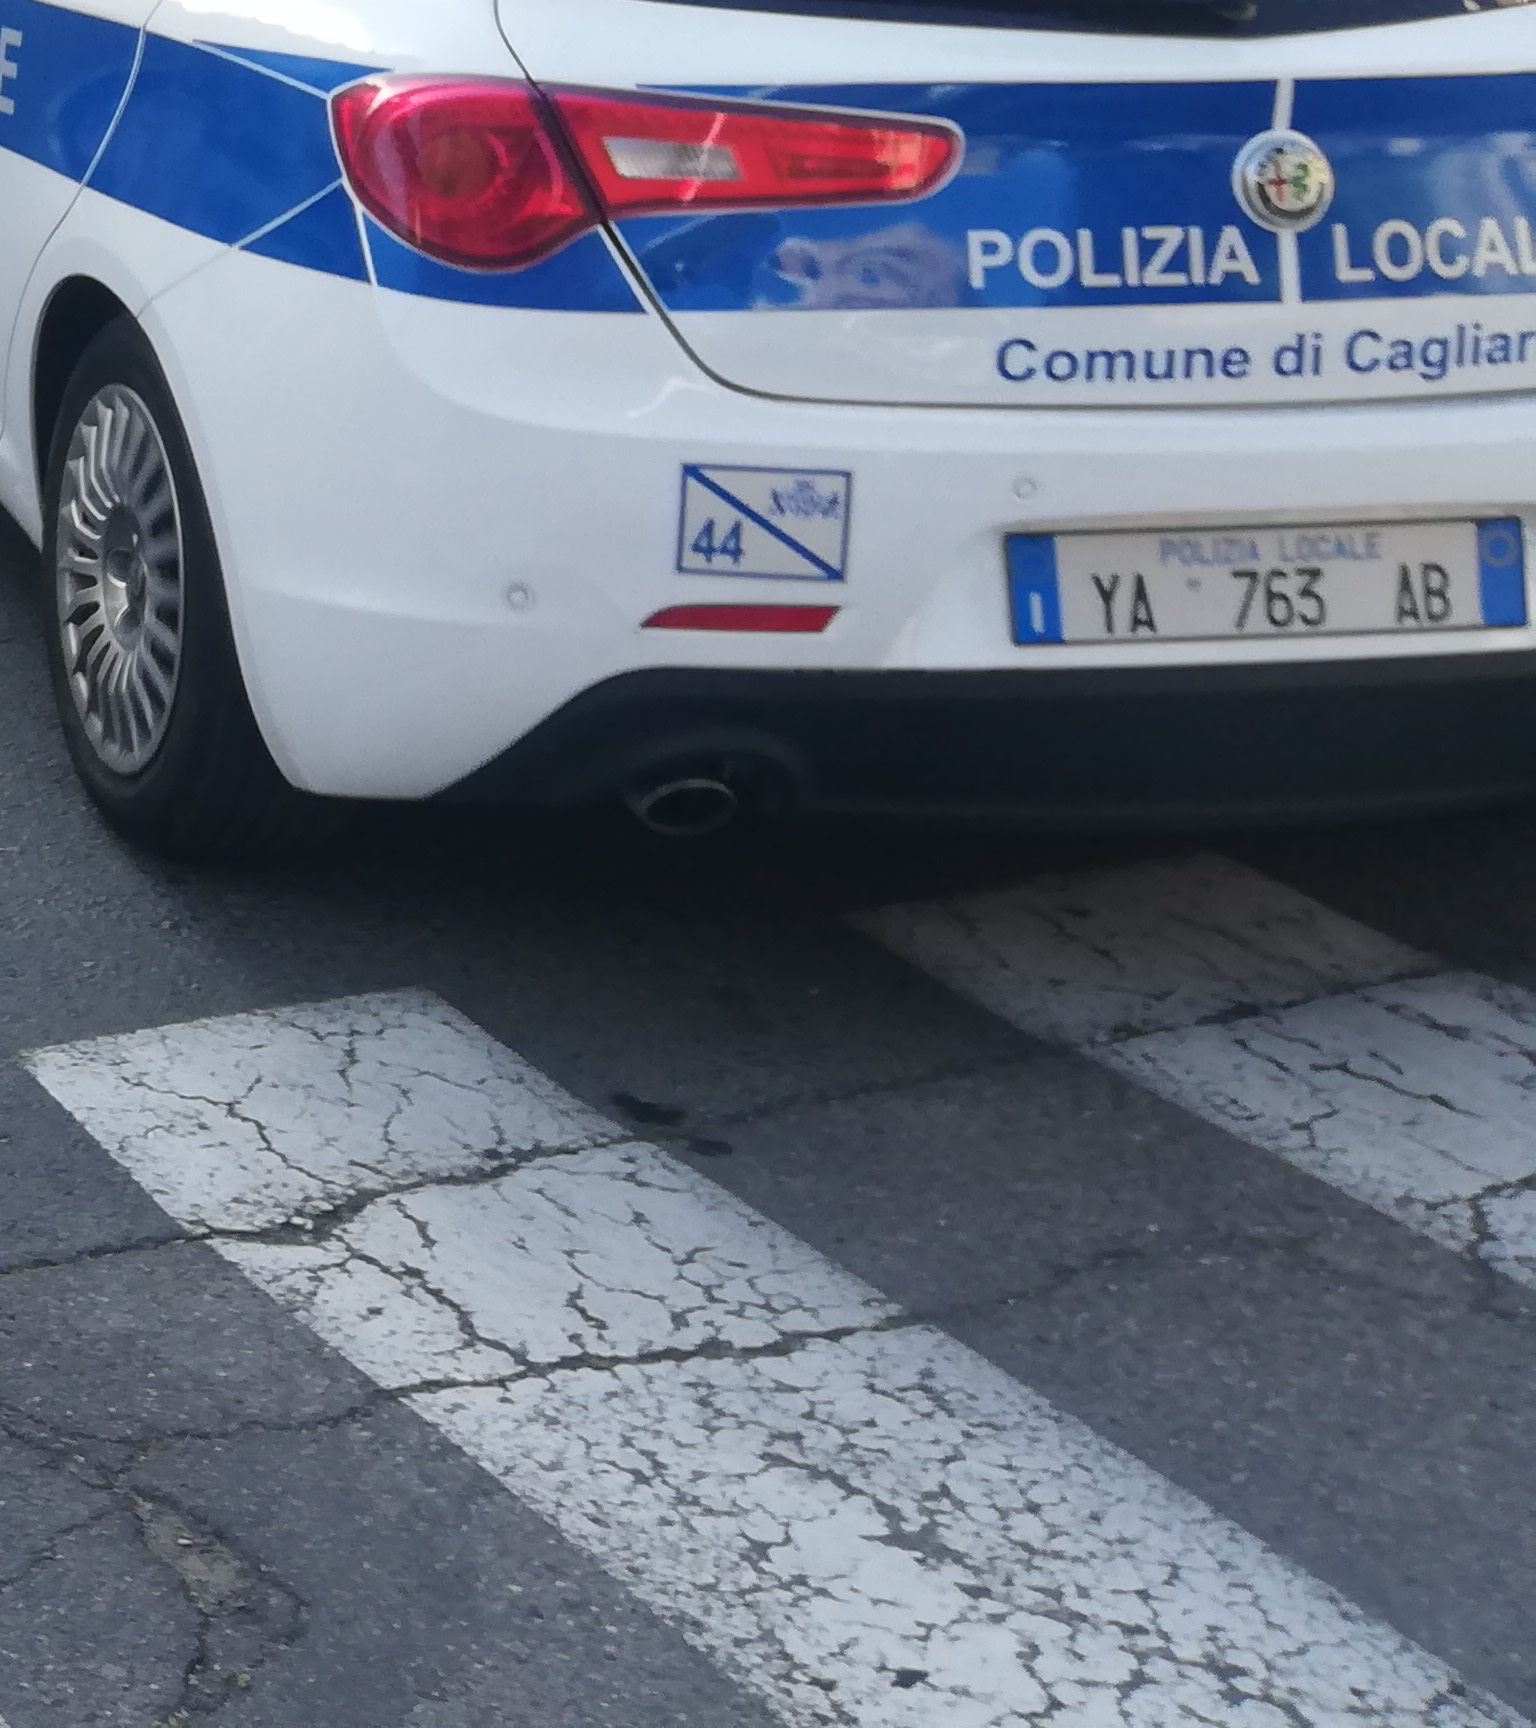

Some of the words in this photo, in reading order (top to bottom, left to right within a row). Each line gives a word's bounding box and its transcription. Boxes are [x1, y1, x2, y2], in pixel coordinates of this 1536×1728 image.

[967, 225, 1261, 290] POLIZIA
[996, 338, 1252, 383] Comune
[1272, 333, 1324, 378] di
[691, 517, 743, 564] 44
[1158, 537, 1261, 567] POLIZIA
[1278, 532, 1383, 563] LOCALE
[1091, 572, 1158, 635] YA
[1230, 565, 1327, 632] 763
[1395, 561, 1454, 625] AB
